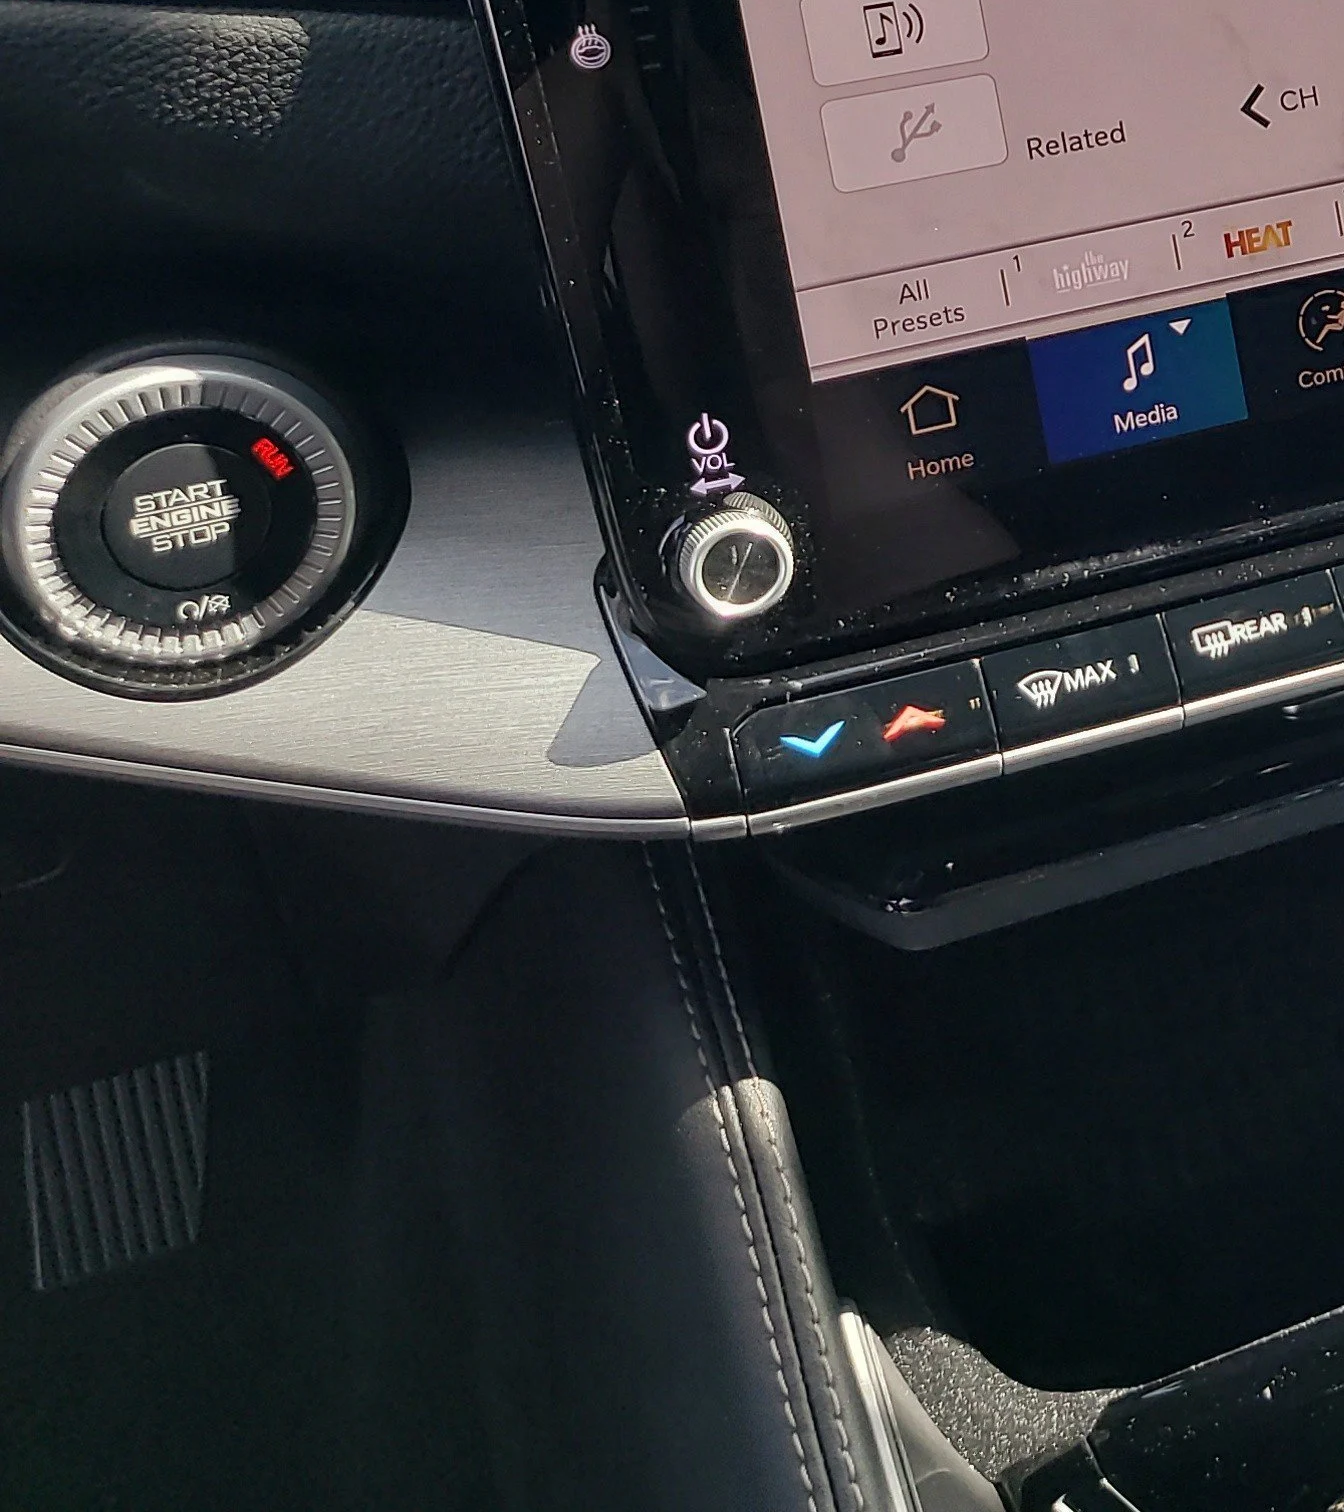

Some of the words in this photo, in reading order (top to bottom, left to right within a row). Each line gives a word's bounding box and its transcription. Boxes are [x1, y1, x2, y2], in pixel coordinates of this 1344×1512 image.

[1280, 85, 1319, 112] CH
[1026, 121, 1127, 160] Related
[1181, 221, 1195, 238] 2
[1224, 220, 1293, 258] HEAT
[1012, 255, 1021, 273] 1
[1053, 260, 1128, 290] highway
[898, 278, 929, 303] All
[873, 303, 966, 339] Presets
[1113, 402, 1179, 434] Media
[691, 453, 733, 473] VOL
[907, 449, 975, 481] Home
[134, 479, 228, 513] START
[130, 499, 242, 536] ENGINE
[152, 522, 231, 553] STOP
[1230, 612, 1289, 644] REAR
[1064, 659, 1117, 692] MAX
